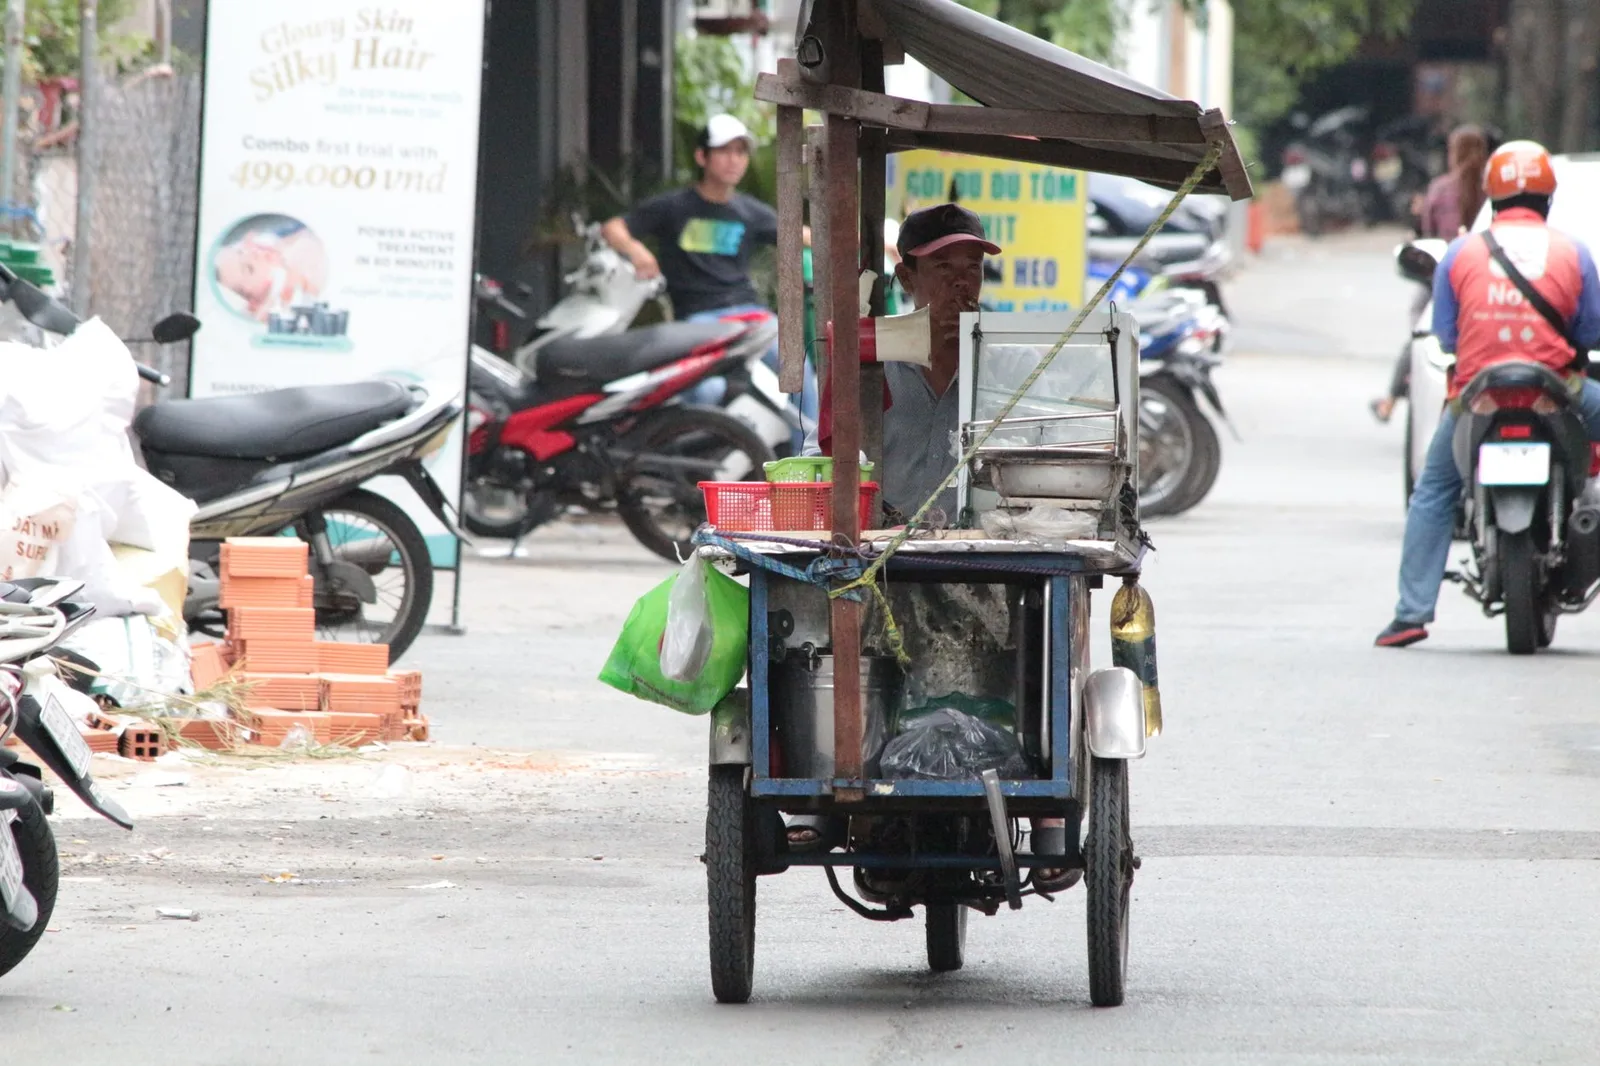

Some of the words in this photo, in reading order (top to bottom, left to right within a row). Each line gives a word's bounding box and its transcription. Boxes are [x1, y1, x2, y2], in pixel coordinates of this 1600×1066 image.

[354, 7, 414, 35] Skin
[248, 49, 338, 103] Silky
[352, 36, 435, 71] Hair
[241, 134, 310, 154] Combo
[315, 137, 351, 156] first
[356, 141, 393, 159] trial
[398, 145, 439, 161] with
[229, 160, 377, 192] 499.000
[384, 162, 448, 193] vnd
[357, 225, 405, 239] POWER
[410, 229, 455, 242] ACTIVE
[377, 241, 455, 256] TREATMENT
[395, 257, 455, 272] MINUTES
